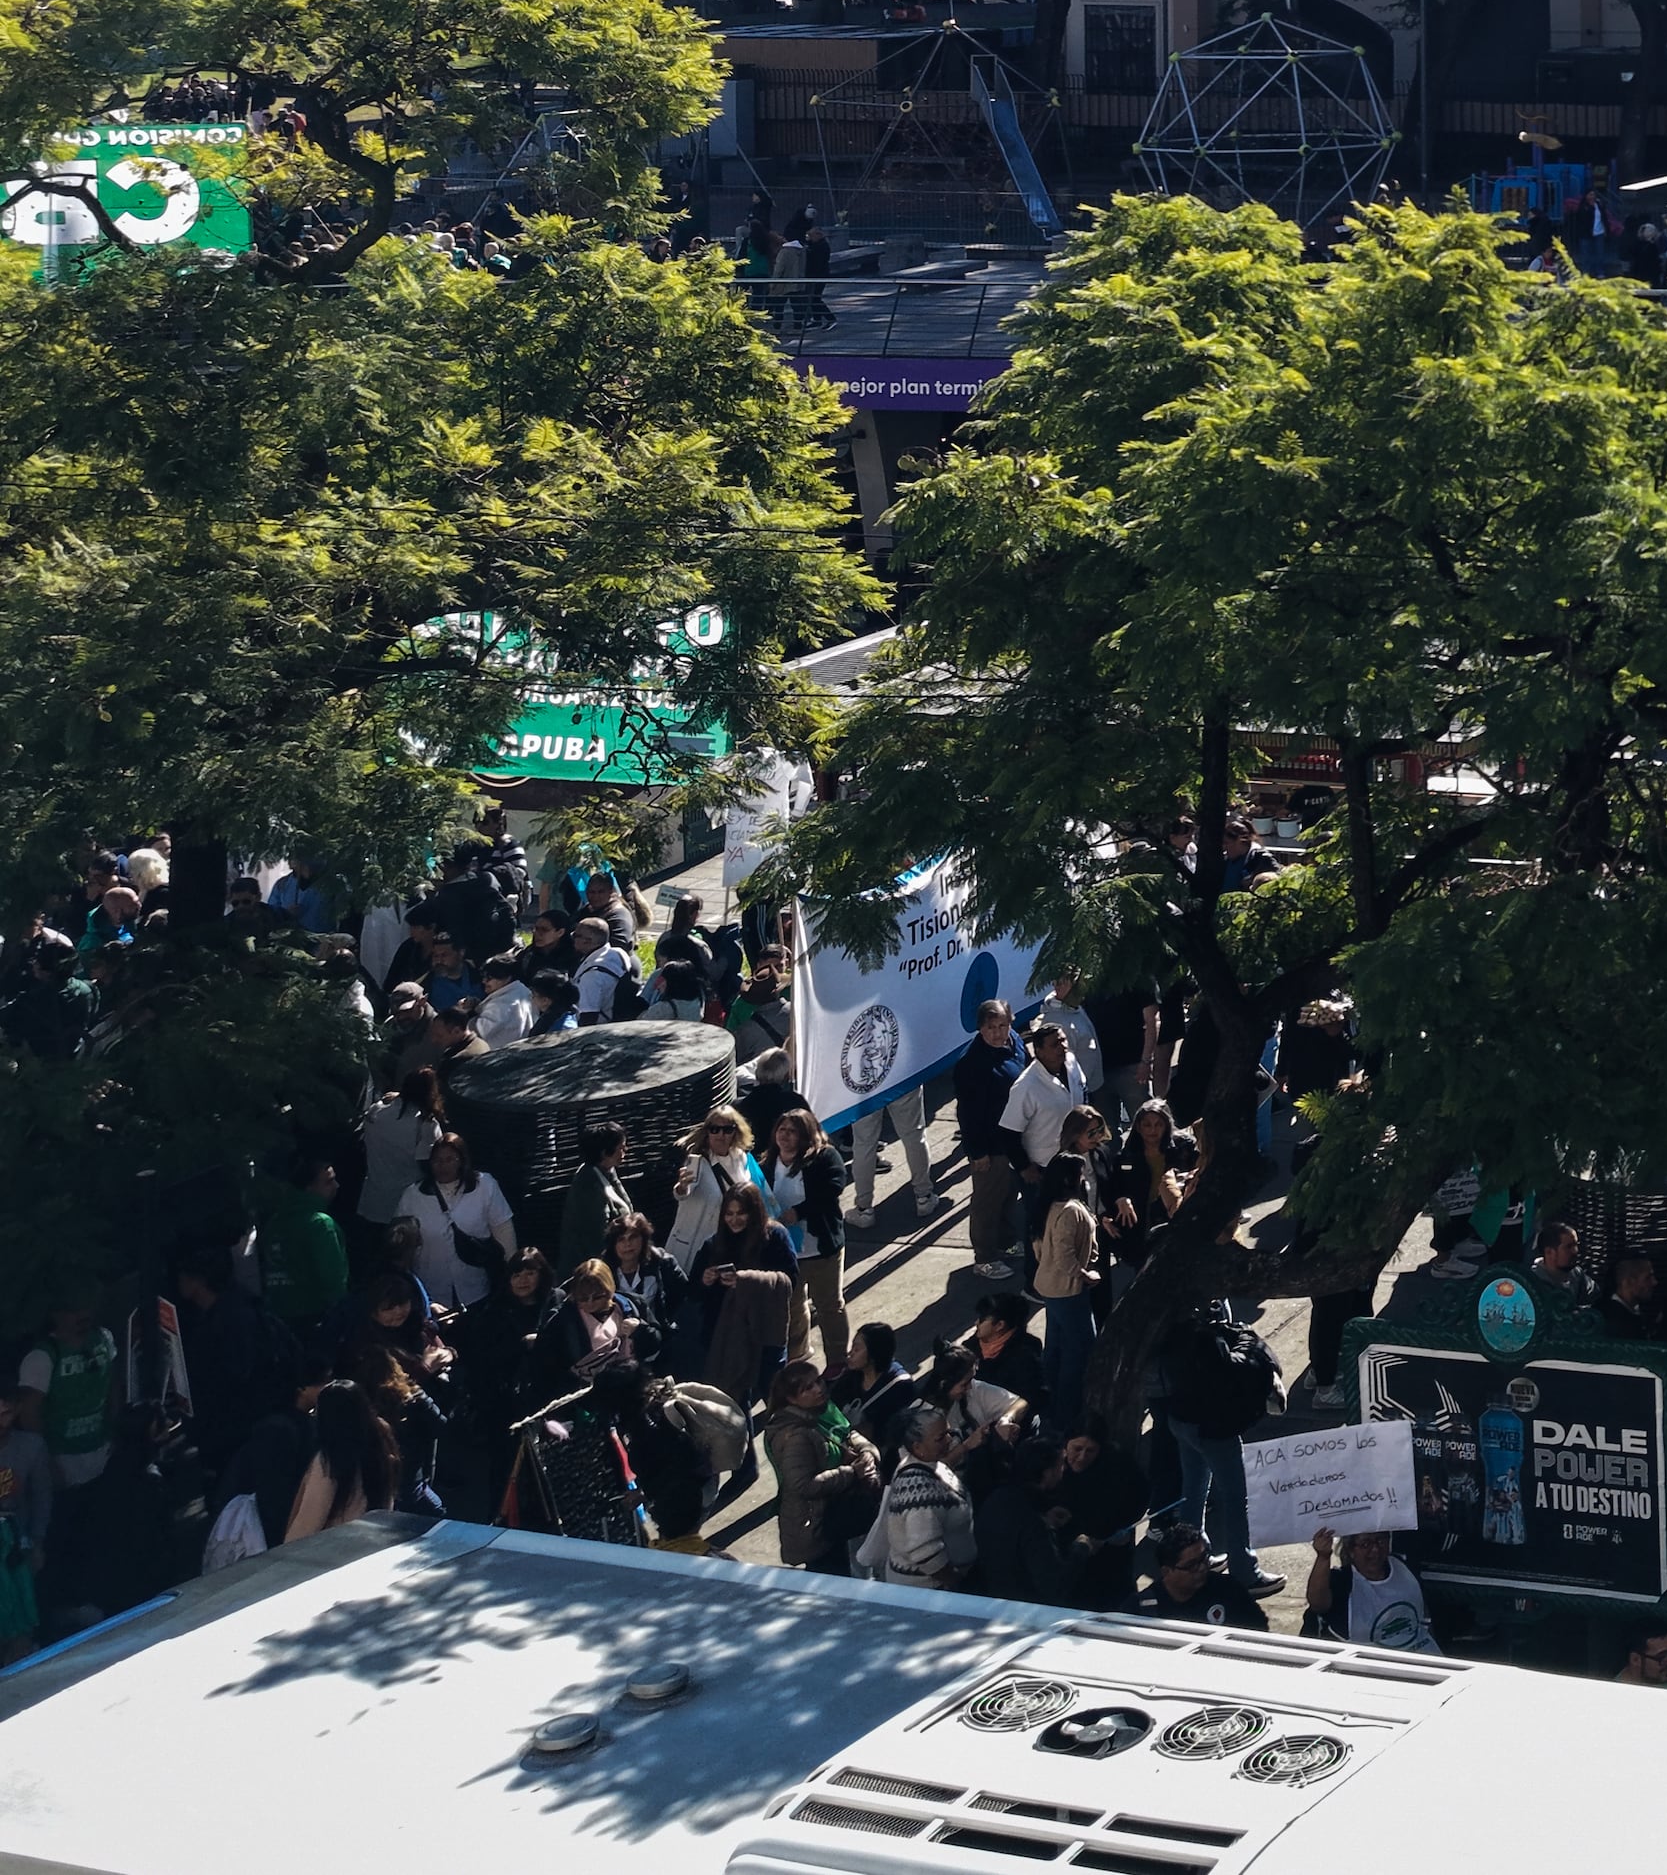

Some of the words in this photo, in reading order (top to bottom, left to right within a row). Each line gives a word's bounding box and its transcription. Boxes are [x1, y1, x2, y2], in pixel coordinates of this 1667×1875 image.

[889, 378, 930, 397] plan
[497, 733, 607, 764] APUBA
[1293, 1437, 1348, 1459] SOMOS
[1532, 1419, 1649, 1455] DALE
[1532, 1447, 1649, 1488] POWER
[1535, 1481, 1548, 1509] A
[1549, 1482, 1574, 1513] TU
[1576, 1484, 1652, 1520] DESTINO
[1575, 1525, 1608, 1537] POWER
